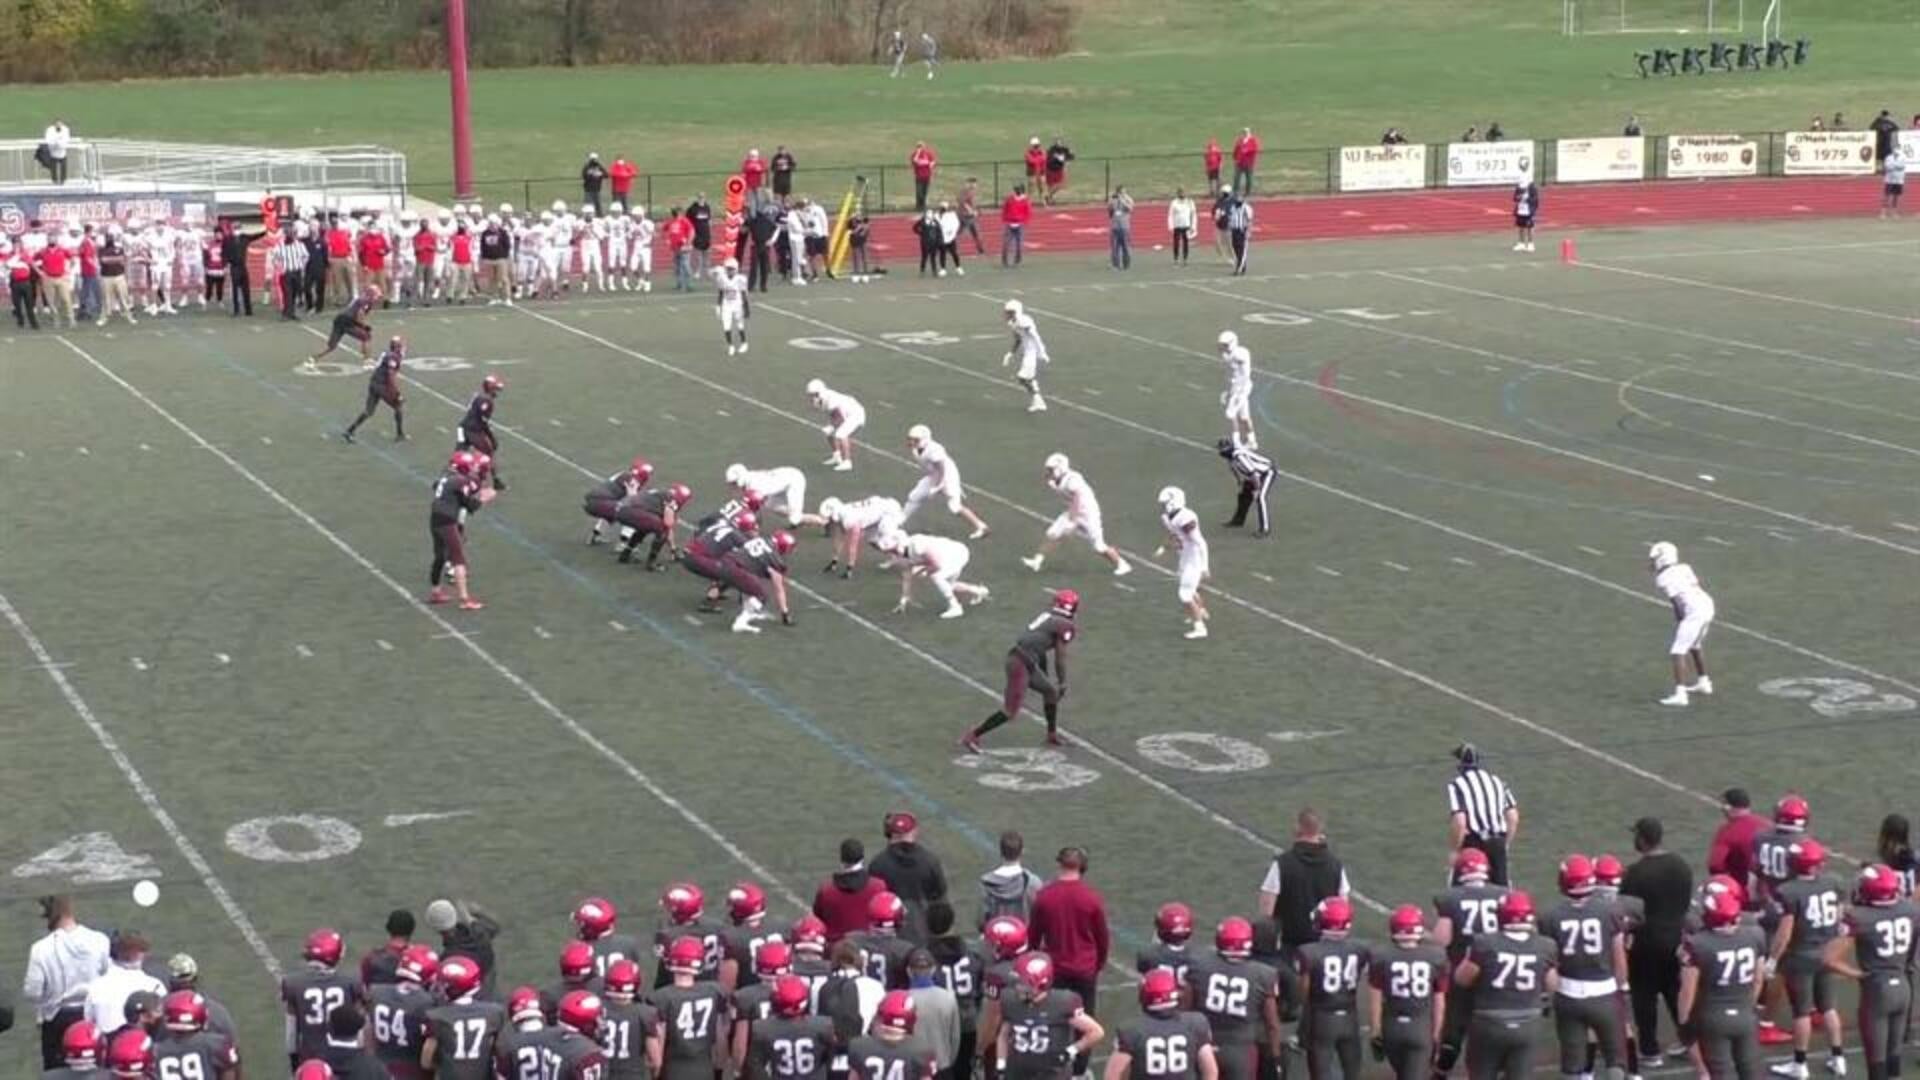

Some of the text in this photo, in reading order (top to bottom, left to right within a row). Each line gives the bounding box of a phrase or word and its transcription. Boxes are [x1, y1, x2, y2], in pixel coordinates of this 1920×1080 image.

[1697, 151, 1729, 163] 1980
[1814, 148, 1849, 161] 1979
[1759, 843, 1786, 879] 40
[1460, 899, 1498, 935] 76
[1806, 891, 1838, 928] 46
[1560, 915, 1602, 955] 79
[1875, 916, 1913, 957] 39
[1322, 954, 1357, 993] 84
[1390, 962, 1431, 999] 28
[1491, 952, 1537, 991] 75
[1717, 947, 1755, 986] 72
[303, 986, 345, 1025] 32
[1206, 972, 1249, 1017] 62
[374, 1003, 409, 1046] 64
[676, 997, 713, 1039] 47
[453, 1018, 487, 1060] 17
[773, 1038, 815, 1075] 36
[1146, 1034, 1188, 1076] 66
[159, 1052, 204, 1080] 69
[865, 1056, 906, 1080] 34
